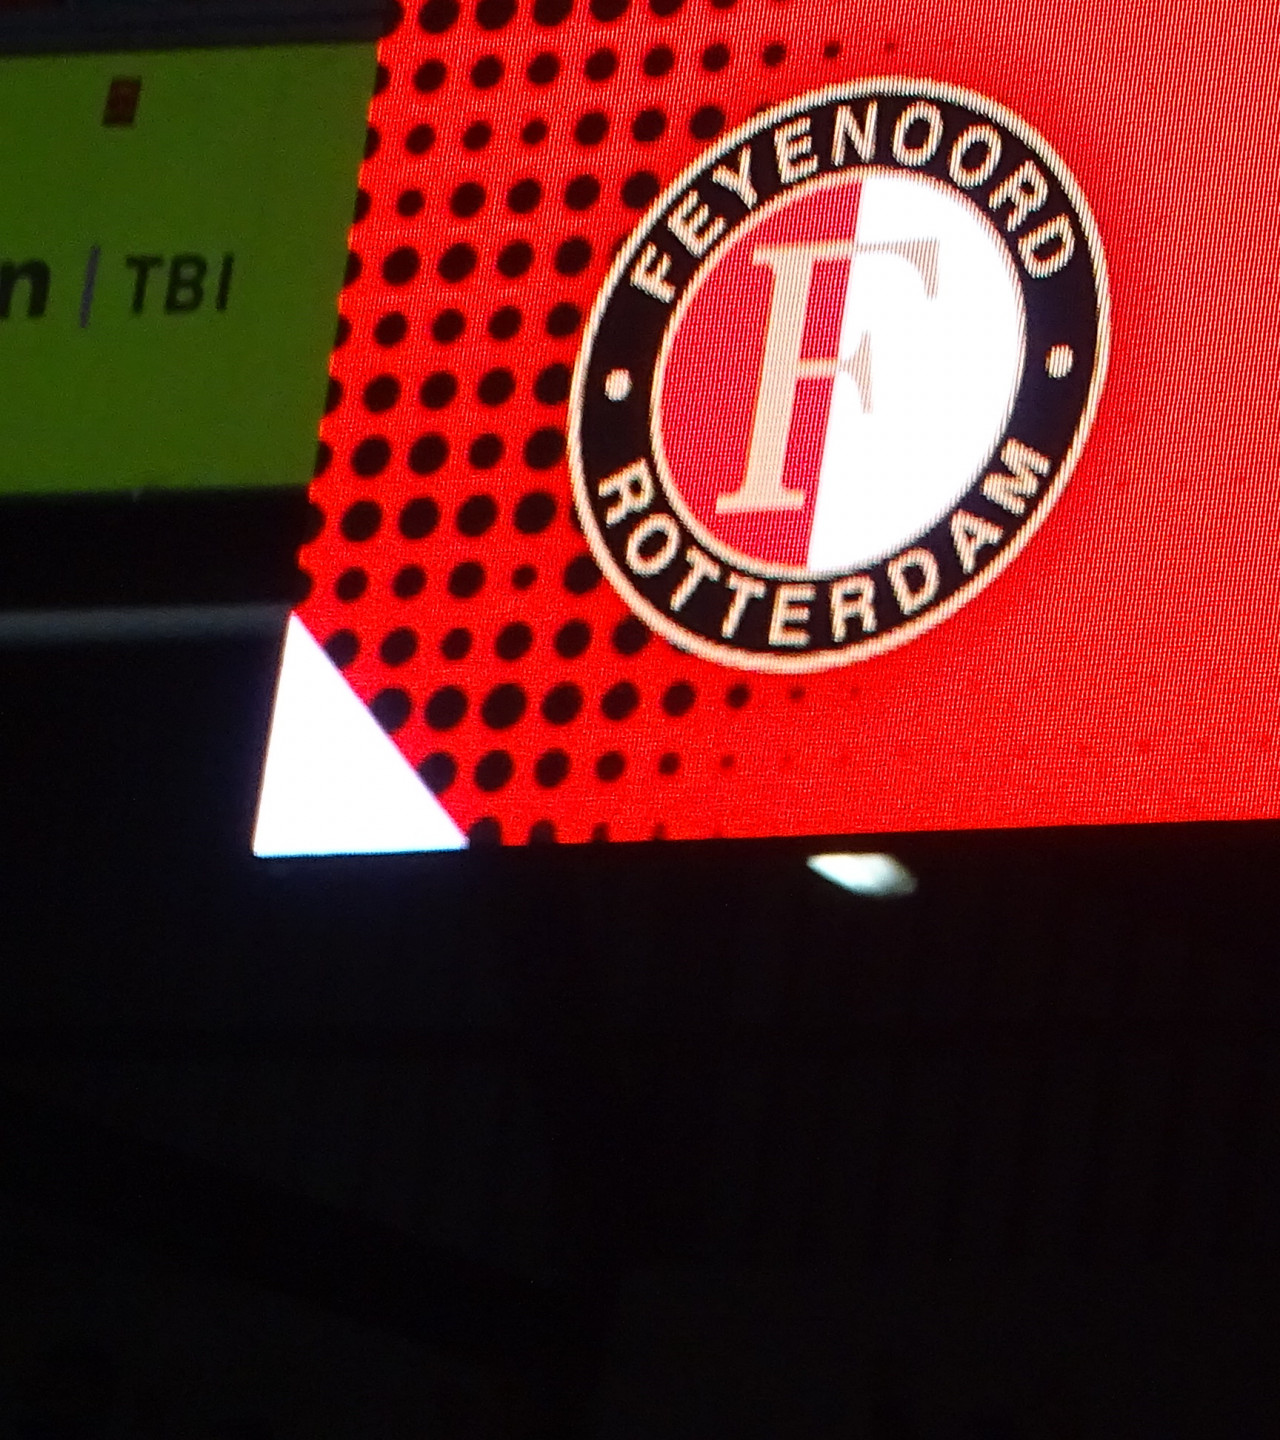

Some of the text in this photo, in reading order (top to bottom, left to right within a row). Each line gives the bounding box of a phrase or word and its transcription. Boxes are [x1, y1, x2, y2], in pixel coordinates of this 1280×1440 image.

[126, 251, 235, 316] TBI
[630, 100, 1076, 303] FEYENOORD
[715, 236, 941, 516] F
[598, 438, 1052, 647] ROTTERDAM
